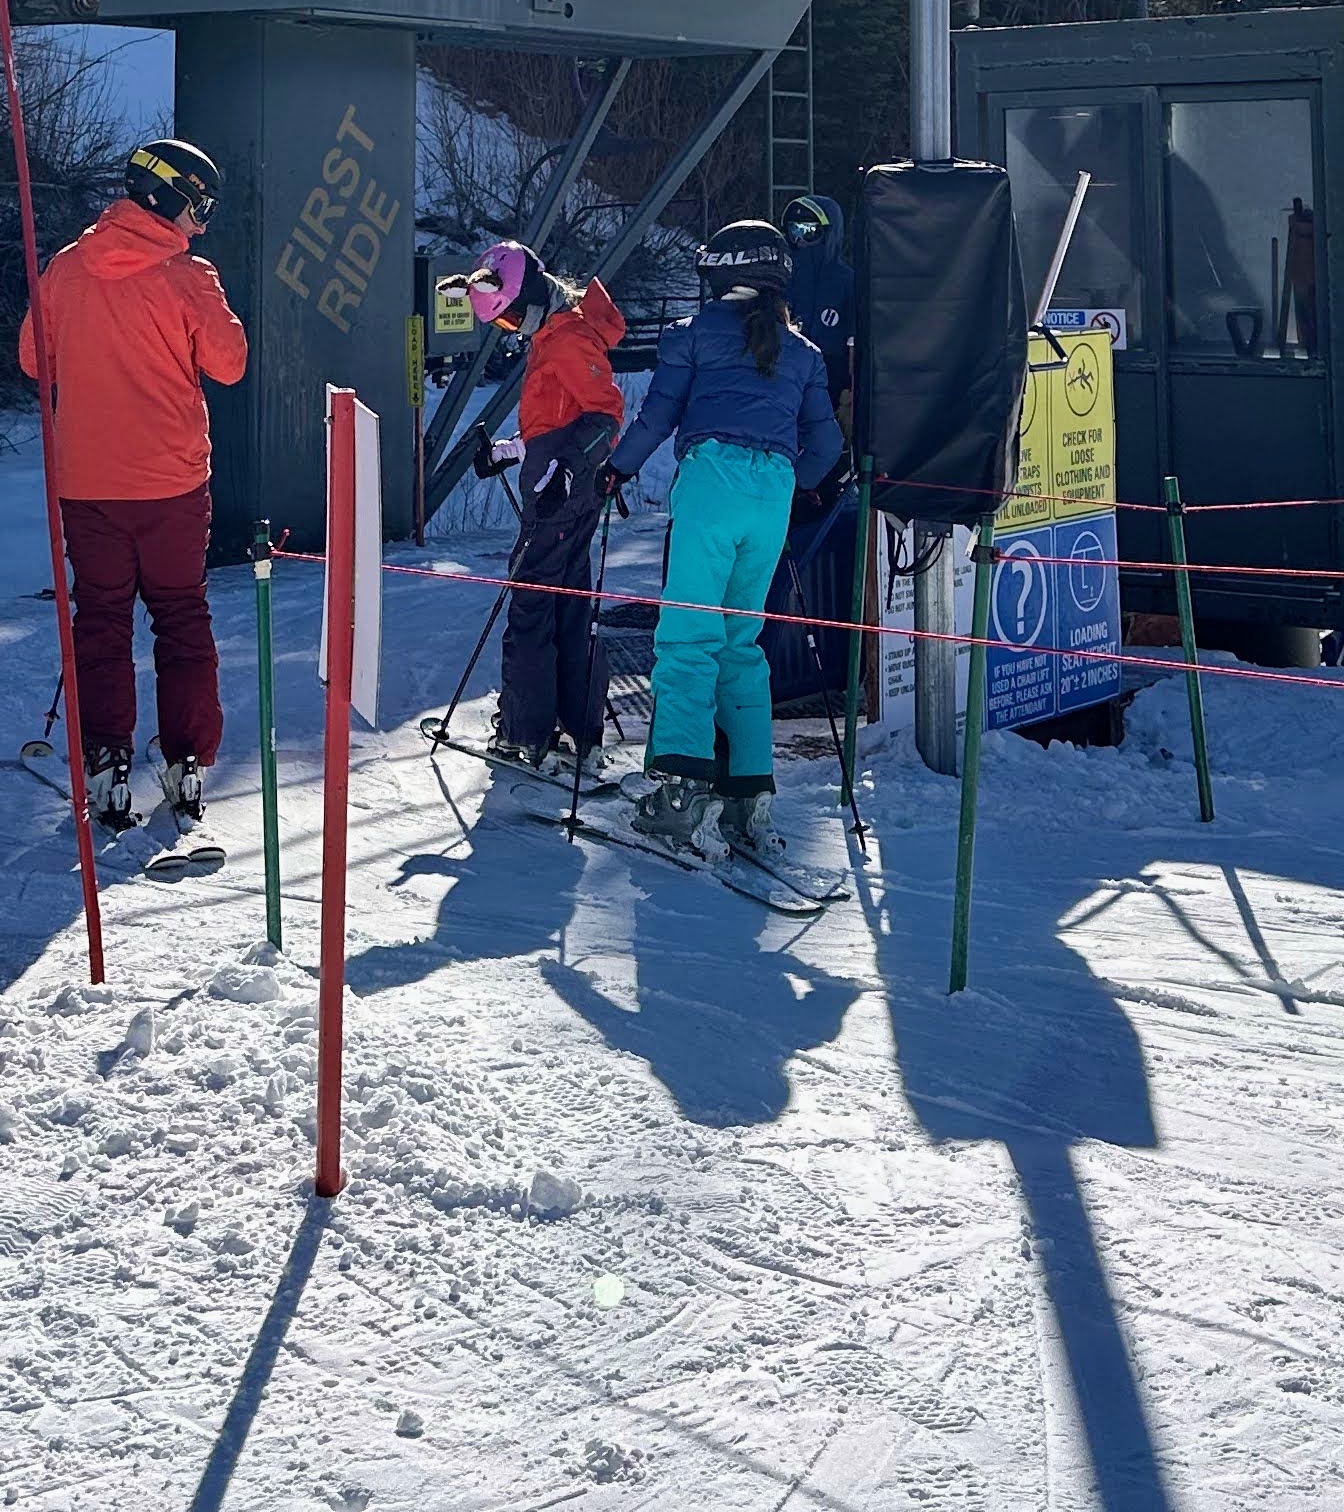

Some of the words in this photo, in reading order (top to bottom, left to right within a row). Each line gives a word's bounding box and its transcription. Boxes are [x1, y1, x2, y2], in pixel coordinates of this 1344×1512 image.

[274, 104, 375, 300] FIRST
[316, 179, 401, 334] RIDE
[698, 251, 751, 266] ZEAL
[1044, 311, 1080, 325] NOTICE
[1062, 430, 1087, 448] CHECK
[1088, 428, 1103, 444] FOR
[1071, 448, 1094, 465] LOOSE
[1019, 465, 1041, 481] TRAPS
[1056, 467, 1093, 487] CLOTHING
[1094, 464, 1110, 480] AND
[1062, 484, 1105, 505] EQUIPMENT
[1012, 498, 1047, 519] UNLOADED
[1070, 621, 1108, 647] LOADING
[994, 665, 1001, 679] IF
[1001, 662, 1016, 676] YOU
[1016, 657, 1033, 673] HAVE
[1034, 653, 1047, 668] NOT
[1062, 652, 1084, 672] SEAT
[991, 678, 1010, 695] USED
[1011, 676, 1016, 689] A
[1017, 671, 1036, 688] CHAIR
[1037, 667, 1050, 682] LIFT
[1081, 671, 1087, 689] 2
[1087, 662, 1118, 687] INCHES
[1016, 685, 1039, 704] PLEASE
[1040, 682, 1053, 696] ASK
[996, 708, 1009, 725] THE
[1010, 697, 1047, 721] ATTENDANT
